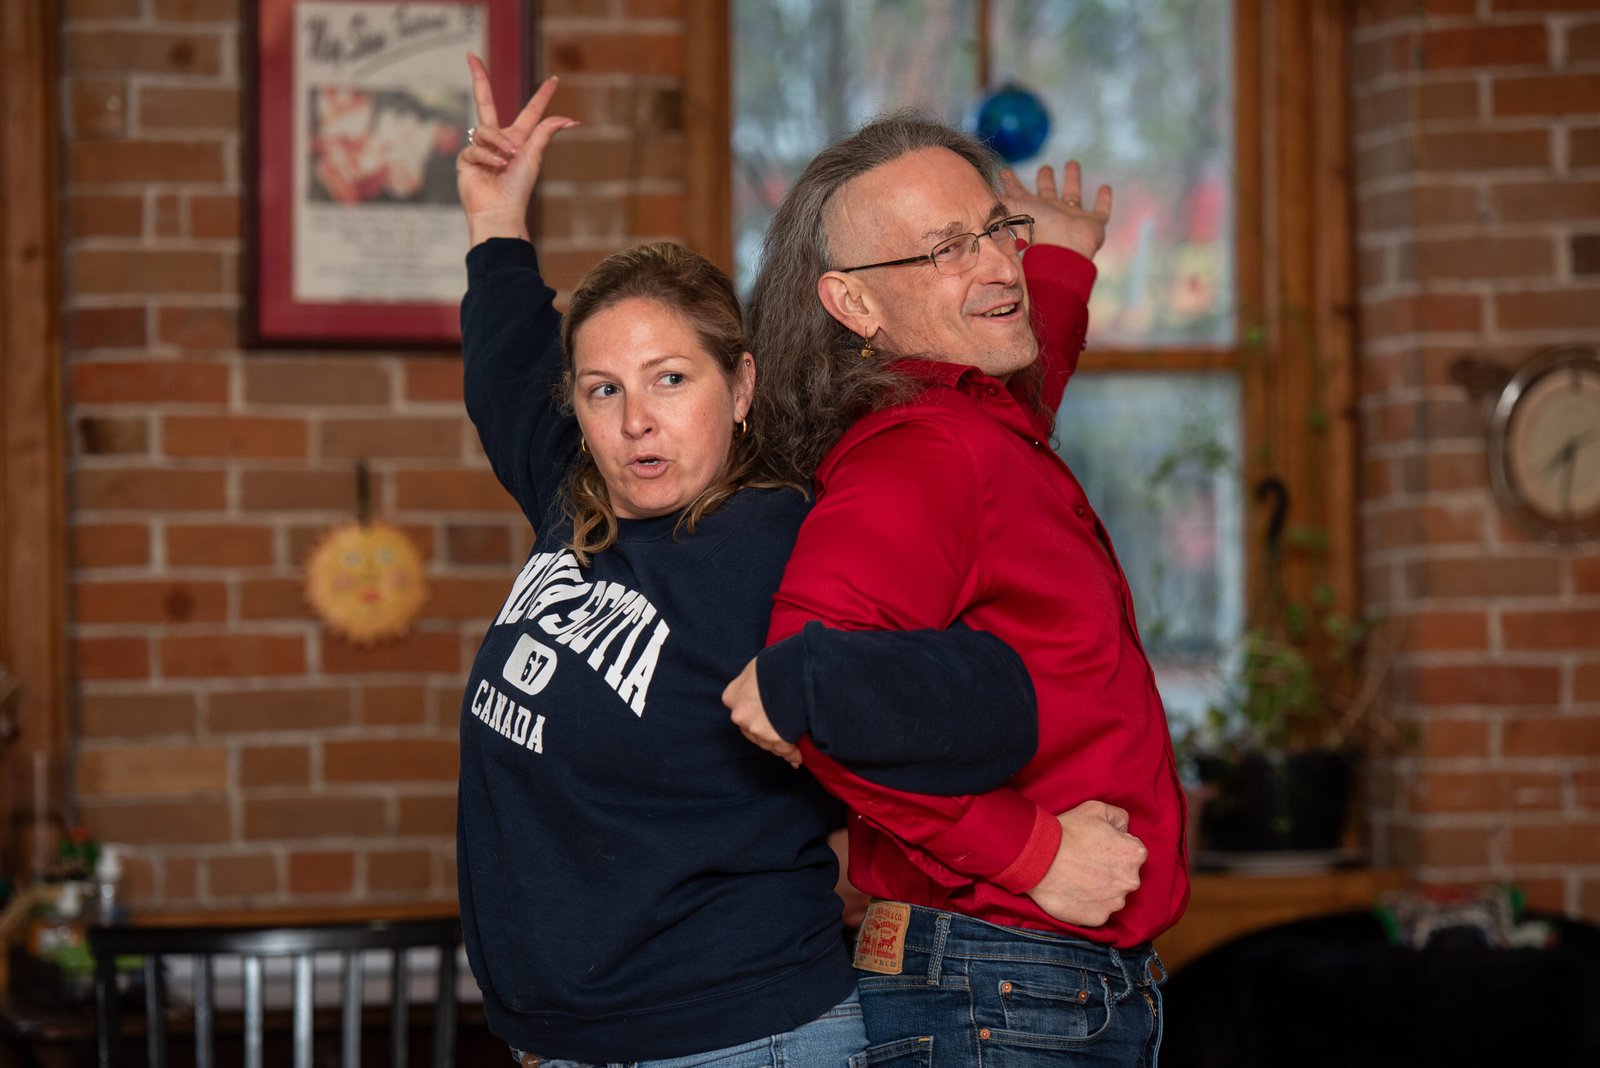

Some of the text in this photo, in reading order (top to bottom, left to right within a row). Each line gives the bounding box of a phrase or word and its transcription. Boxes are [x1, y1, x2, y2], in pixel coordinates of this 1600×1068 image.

[520, 650, 550, 686] 67
[538, 580, 670, 718] SCOTIA
[471, 678, 546, 754] CANADA
